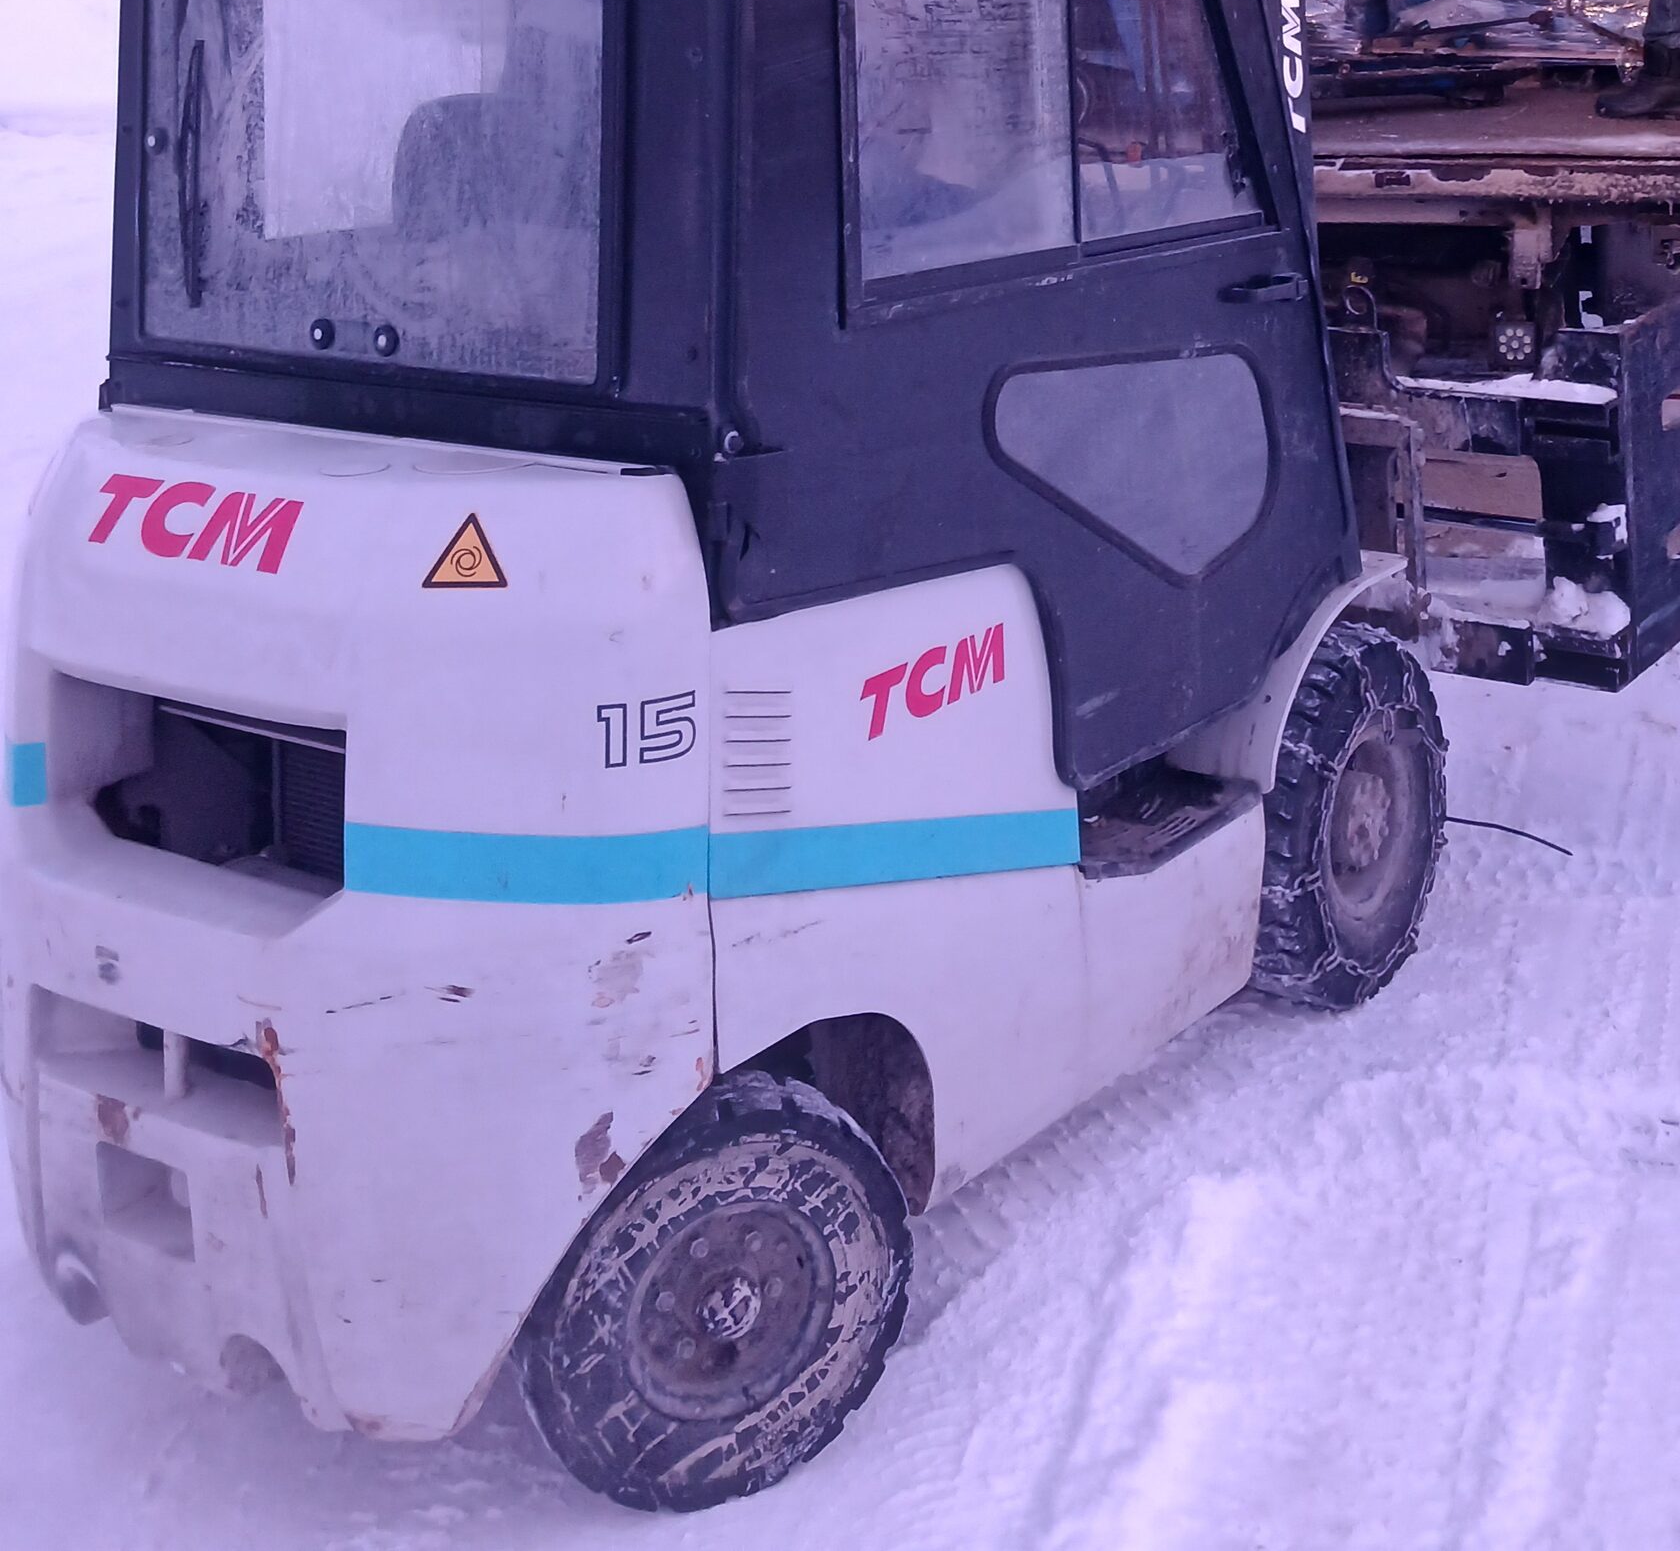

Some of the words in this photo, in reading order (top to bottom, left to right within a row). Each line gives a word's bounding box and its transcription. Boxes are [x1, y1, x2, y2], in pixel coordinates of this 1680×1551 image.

[88, 473, 304, 574] TCM
[597, 690, 697, 769] 15
[860, 622, 1005, 740] TCM
